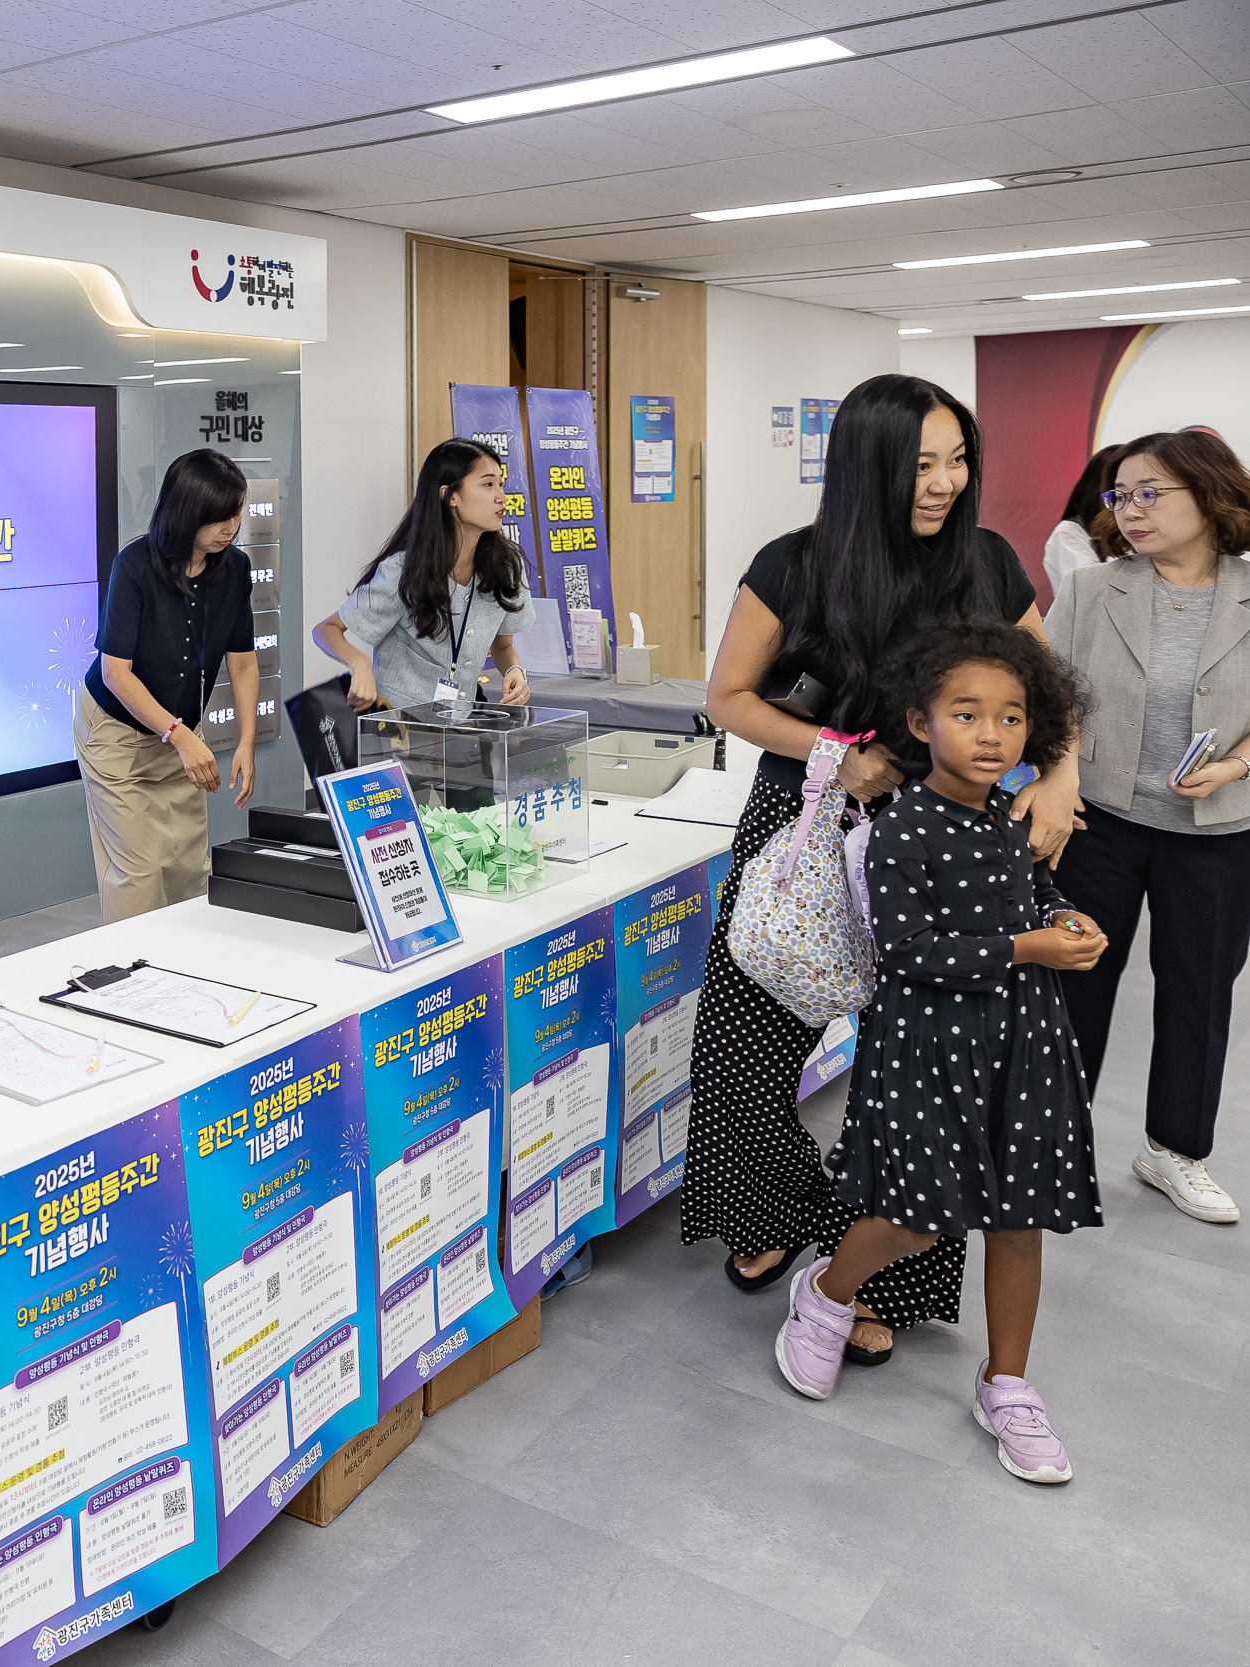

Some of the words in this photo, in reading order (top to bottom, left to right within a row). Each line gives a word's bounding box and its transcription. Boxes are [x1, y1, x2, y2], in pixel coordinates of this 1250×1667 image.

[239, 274, 294, 310] 행복광진
[215, 391, 248, 412] 올해의
[199, 415, 230, 443] 구민
[234, 415, 264, 443] 대상
[549, 466, 586, 490] 온라인
[546, 496, 594, 521] 양성평등
[549, 527, 597, 553] 낱말퀴즈
[346, 797, 366, 812] 광진구
[366, 786, 403, 808] 양성평등주간
[362, 780, 381, 793] 2025년
[514, 776, 582, 828] 경품추첨
[367, 804, 392, 820] 기념행사
[370, 845, 390, 864] 사전
[387, 837, 415, 860] 신청자
[378, 864, 411, 887] 접수하는
[409, 859, 422, 878] 곳
[650, 885, 676, 908] 2025년
[624, 916, 648, 947] 광진구
[650, 893, 702, 932] 양성평등주간
[546, 929, 576, 956] 2025년
[645, 925, 680, 957] 기념행사
[513, 964, 544, 999] 광진구
[547, 937, 605, 981] 양성평등주간
[416, 985, 451, 1018] 2025년
[540, 973, 579, 1010] 기념행사
[374, 1027, 415, 1068] 광진구
[418, 993, 488, 1048] 양성평등주간
[410, 1034, 458, 1079] 기념행사
[249, 1056, 294, 1097] 2025년
[197, 1107, 249, 1158] 광진구
[253, 1060, 341, 1129] 양성평등주간
[245, 1110, 304, 1166] 기념행사
[34, 1150, 96, 1199] 2025년
[38, 1152, 160, 1236] 양성평등주간
[24, 1212, 110, 1278] 기념행사
[17, 1306, 38, 1328] 9월
[40, 1288, 77, 1315] 4일(목)
[79, 1279, 97, 1296] 오후
[98, 1266, 118, 1287] 2시
[33, 1312, 65, 1339] 광진구청
[66, 1305, 81, 1323] 5층
[81, 1293, 103, 1313] 대강당
[28, 1359, 58, 1380] 양성평등
[58, 1347, 80, 1366] 기념식
[81, 1341, 89, 1354] 및
[89, 1329, 109, 1348] 인형극
[428, 1326, 468, 1367] 광진구가족센터
[136, 1434, 173, 1455] 02-458-0622
[343, 1445, 374, 1479] MEASURE:
[344, 1428, 376, 1462] N.WEIGHT:
[91, 1489, 114, 1511] 온라인
[114, 1475, 142, 1498] 양성평등
[142, 1461, 175, 1483] 낱말퀴즈
[280, 1441, 322, 1493] 광진구가족센터
[4, 1538, 34, 1566] 양성평등
[35, 1522, 58, 1545] 인형극
[57, 1593, 134, 1644] 광진구가족센터
